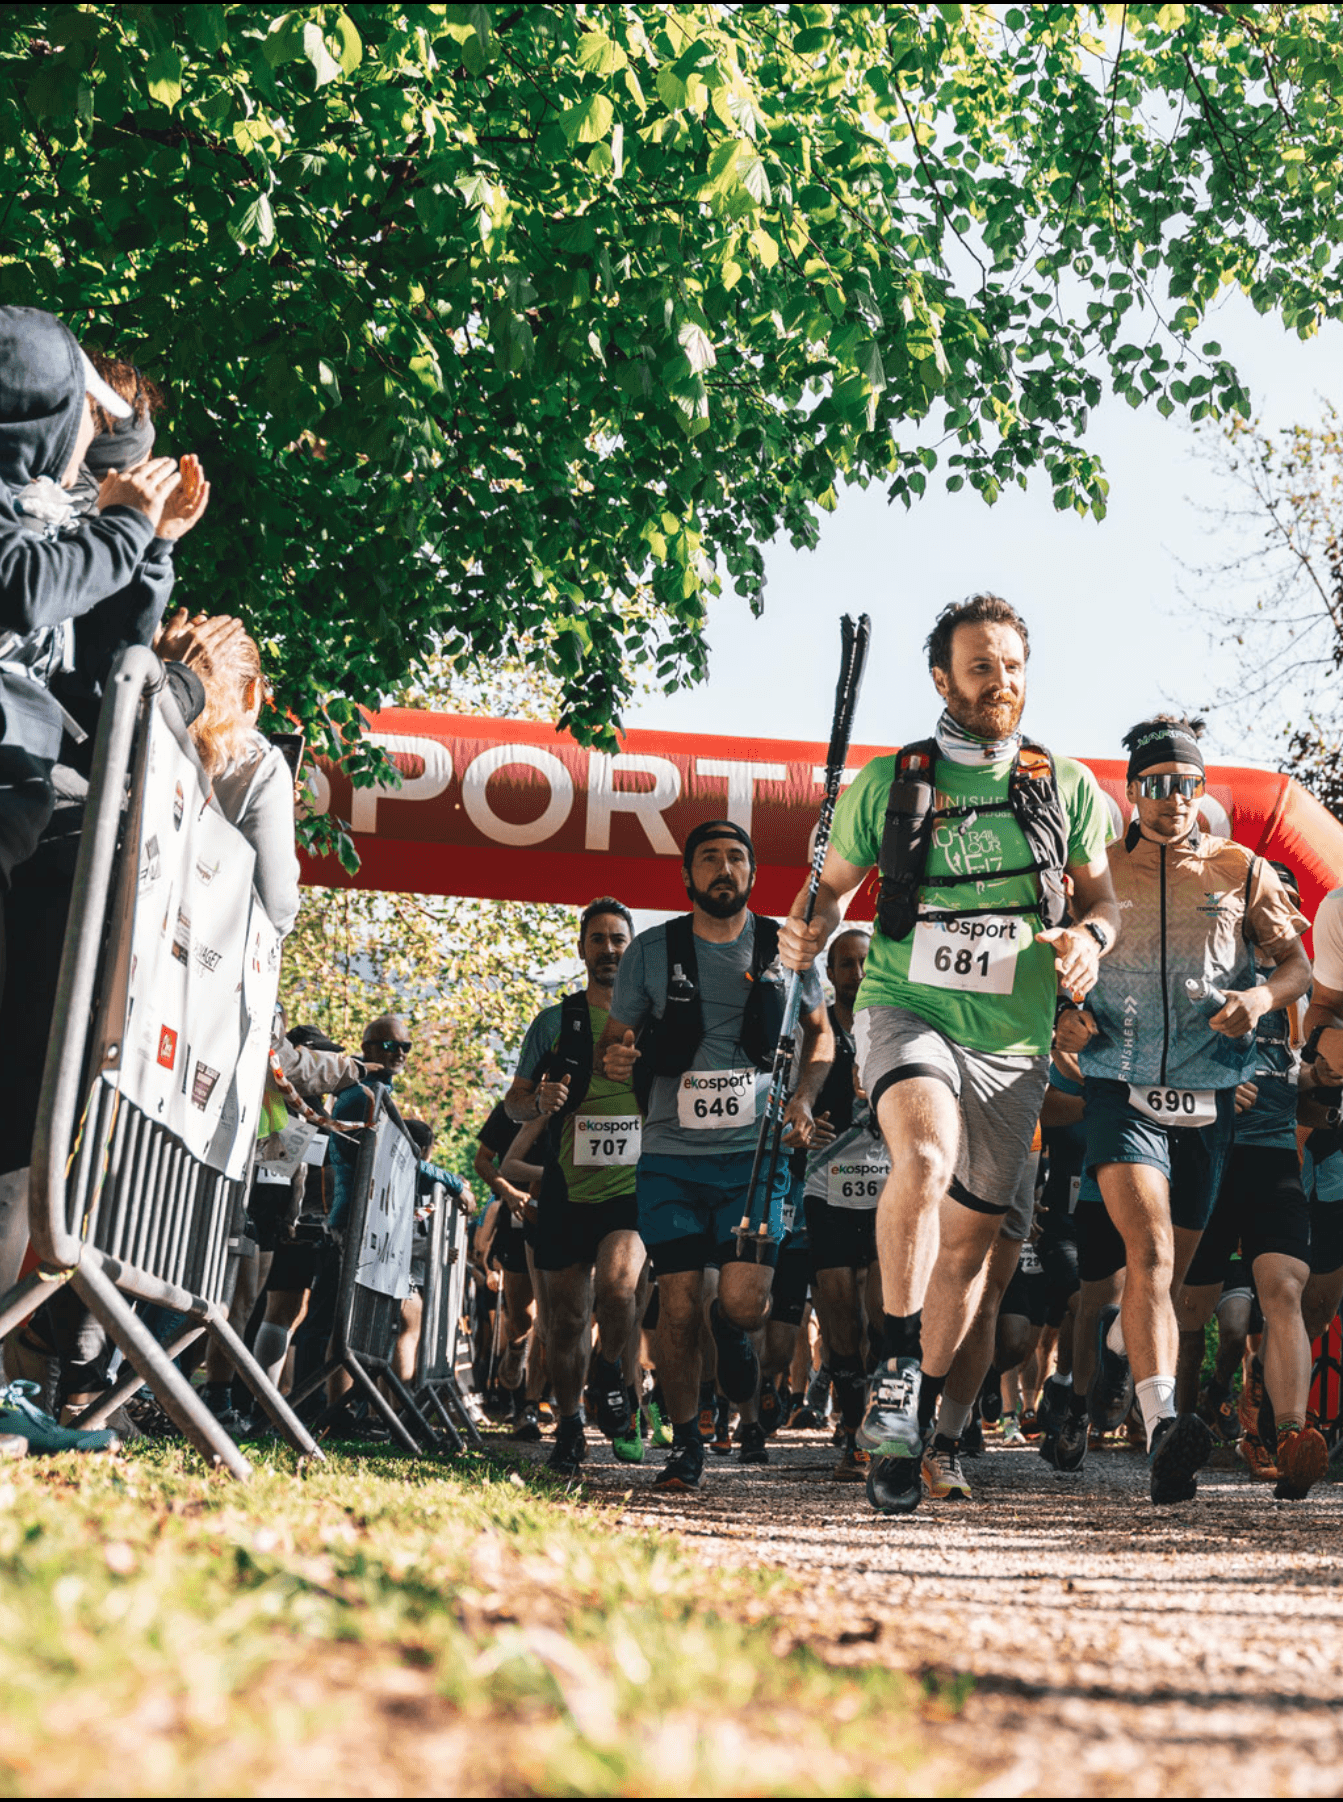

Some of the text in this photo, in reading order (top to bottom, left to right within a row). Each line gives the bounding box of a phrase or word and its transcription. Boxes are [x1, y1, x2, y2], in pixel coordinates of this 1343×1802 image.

[934, 945, 990, 977] 681
[1118, 1019, 1135, 1082] FINISHER
[684, 1071, 752, 1090] ekosport
[694, 1097, 739, 1118] 646
[1146, 1089, 1196, 1114] 690
[578, 1118, 639, 1134] ekosport
[590, 1138, 628, 1156] 707
[831, 1161, 890, 1177] ekosport
[842, 1180, 877, 1197] 636
